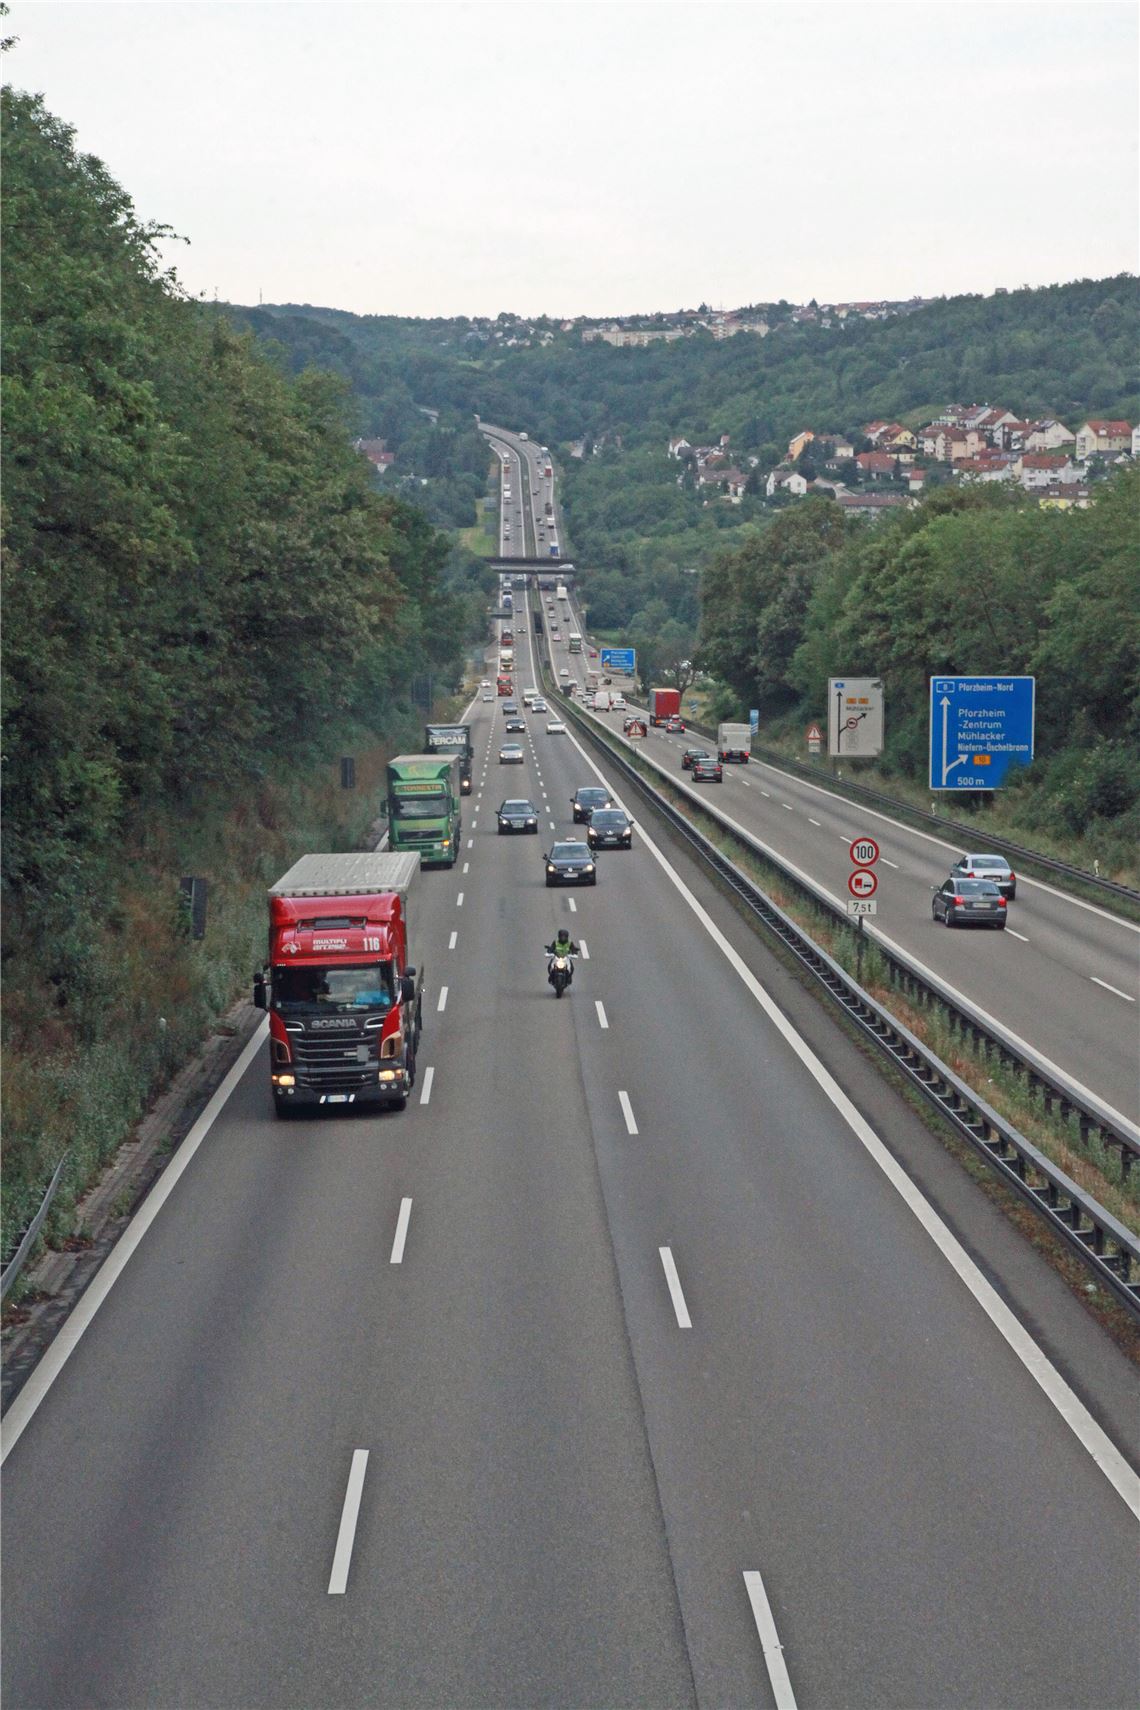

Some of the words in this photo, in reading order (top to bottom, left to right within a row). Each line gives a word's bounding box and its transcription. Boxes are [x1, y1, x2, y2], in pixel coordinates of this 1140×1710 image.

[958, 683, 1014, 692] Pforzheim-Nord
[958, 708, 1006, 718] Pforzheim
[957, 731, 1006, 740] Mühlacker
[957, 742, 1029, 752] Niefern-Öschelbronn
[957, 776, 974, 786] 500
[975, 778, 985, 786] m
[856, 845, 874, 859] 100
[363, 937, 380, 952] 116
[311, 1018, 357, 1029] SCANIA
